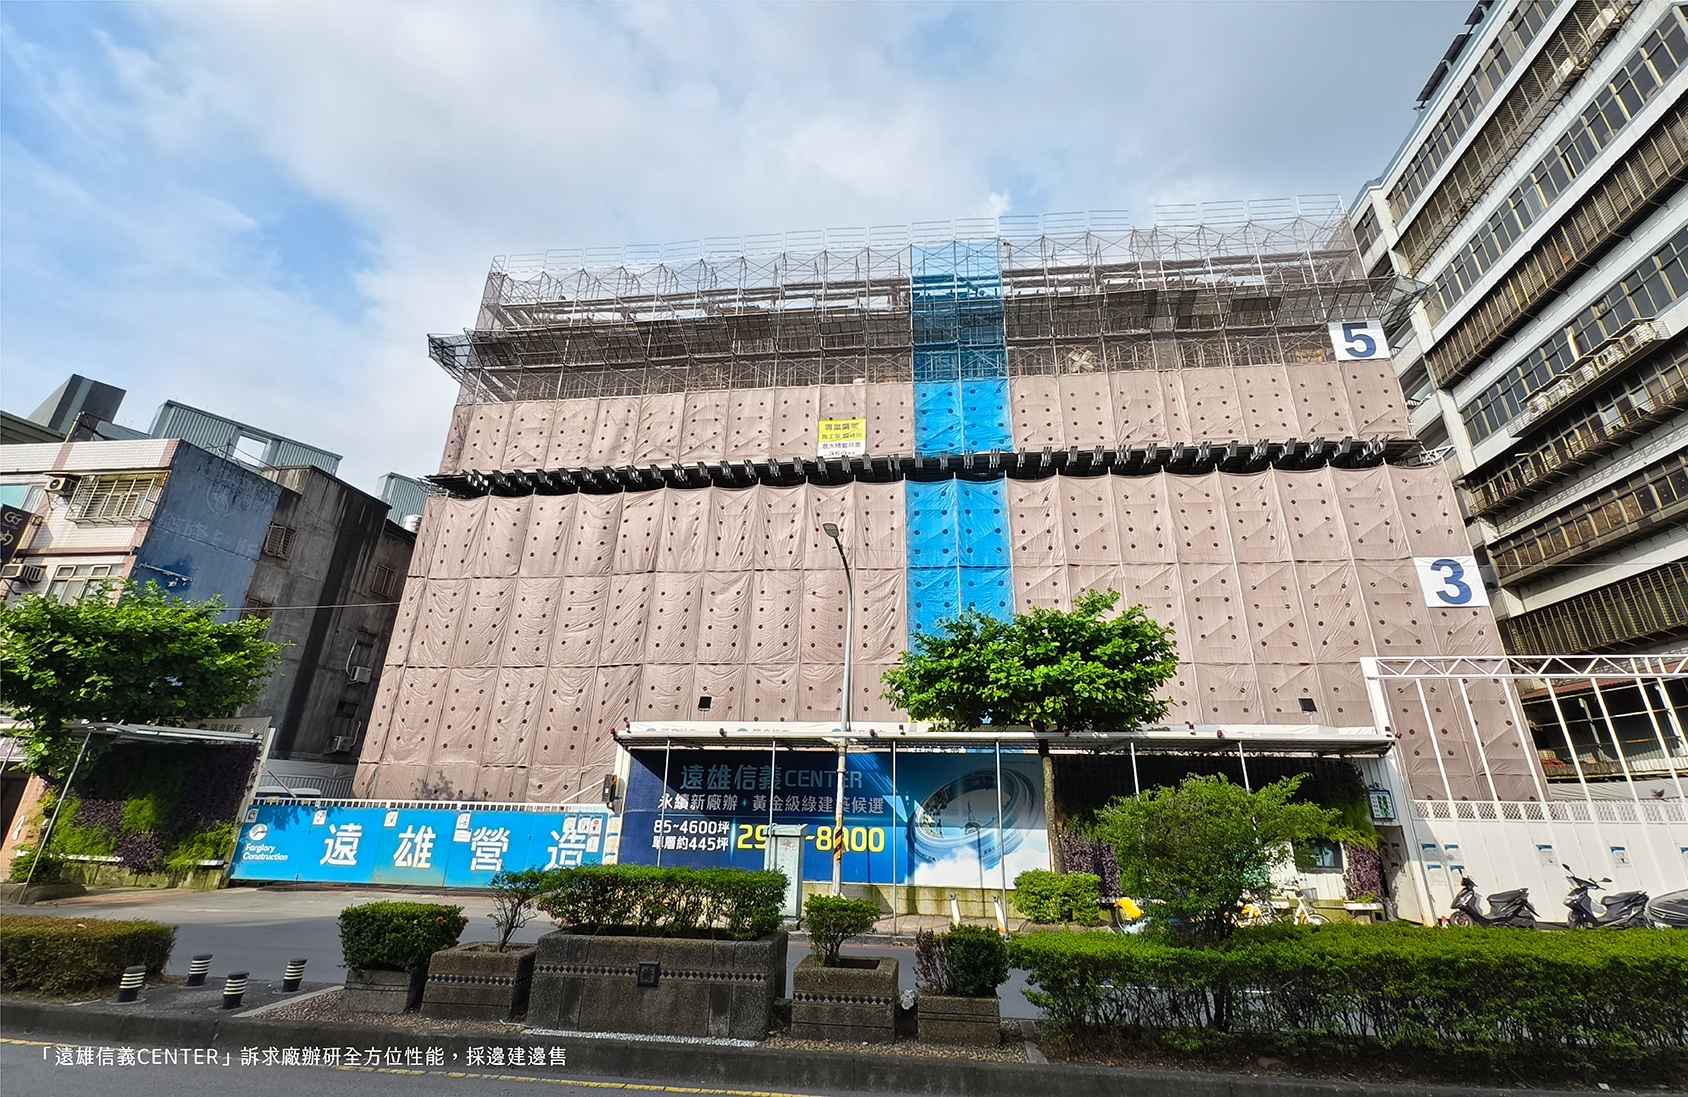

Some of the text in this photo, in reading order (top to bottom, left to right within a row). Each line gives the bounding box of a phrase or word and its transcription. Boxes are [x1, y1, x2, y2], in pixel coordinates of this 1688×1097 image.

[1342, 322, 1377, 358] 5
[1430, 559, 1473, 604] 3
[245, 843, 275, 854] Farglory
[737, 823, 885, 853] 29-8000
[242, 851, 288, 862] Construction
